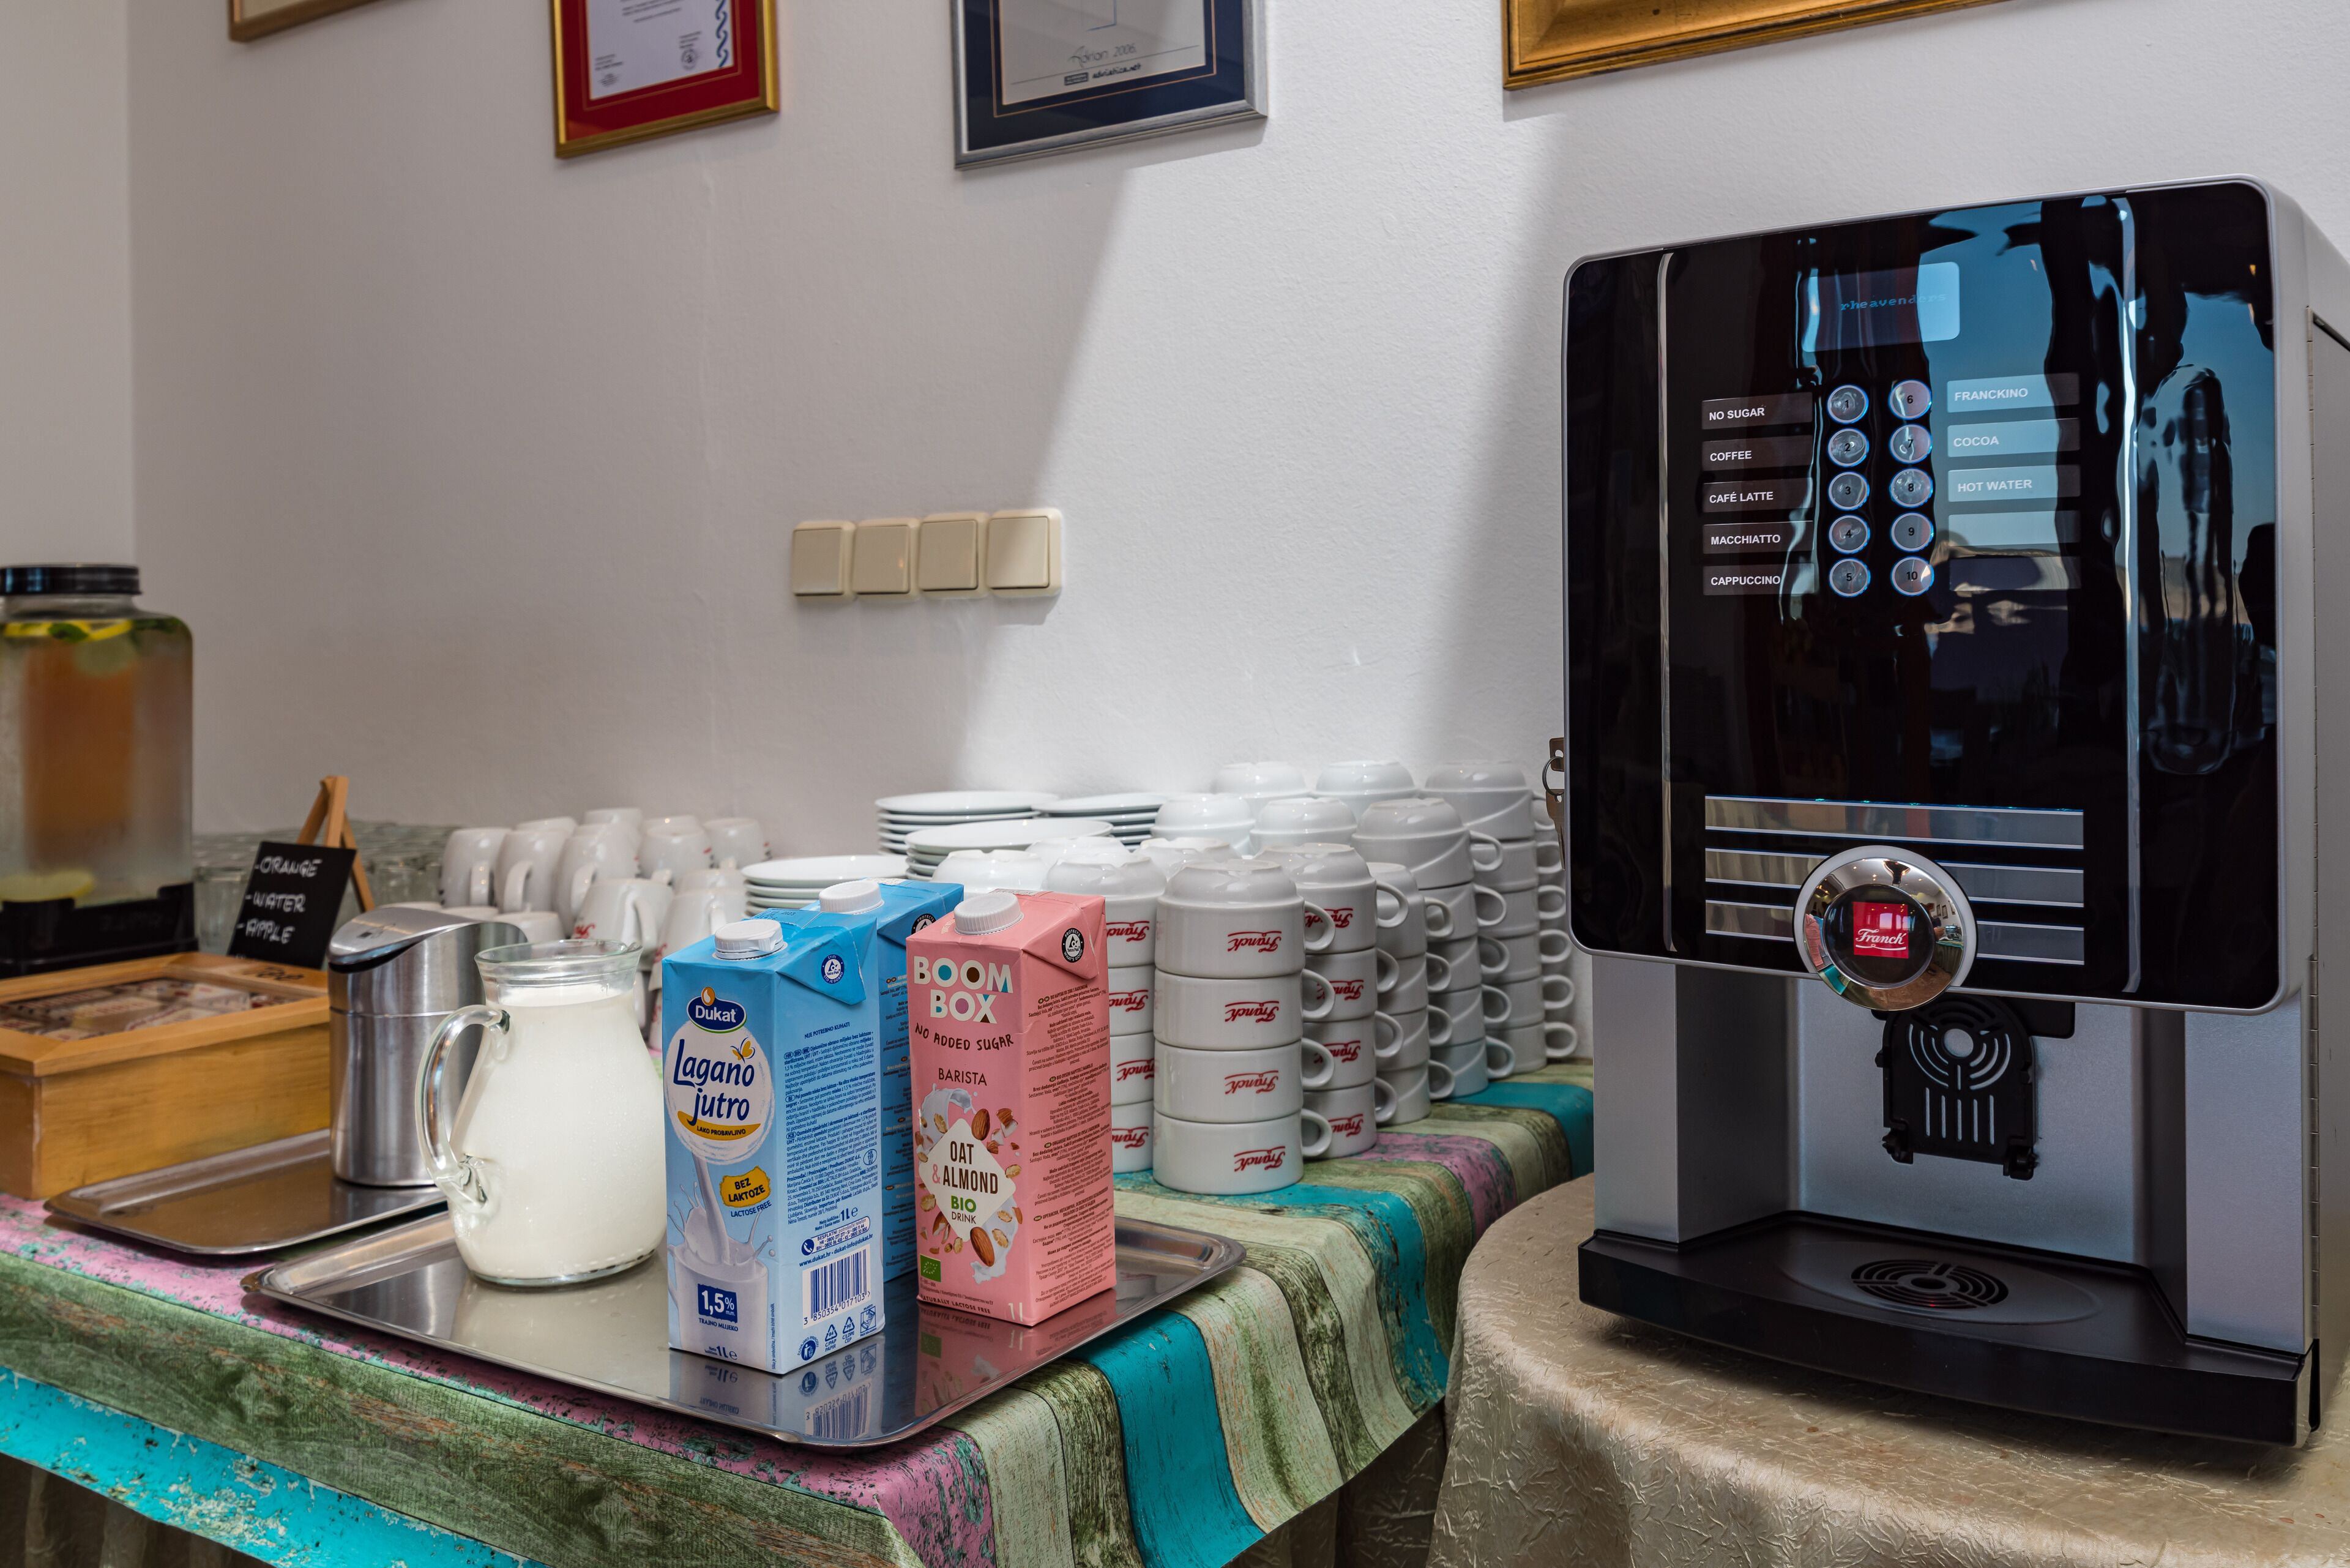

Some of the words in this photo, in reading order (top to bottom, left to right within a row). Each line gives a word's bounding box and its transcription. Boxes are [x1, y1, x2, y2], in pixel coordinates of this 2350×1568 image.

[1840, 294, 1946, 311] rheavenders
[1907, 395, 1914, 405] 6
[1954, 388, 2028, 401] FRANCKINO
[1845, 400, 1850, 408] 1
[1709, 411, 1725, 421] NO
[1727, 407, 1765, 419] SUGAR
[1845, 442, 1851, 452] 2
[1908, 438, 1914, 449] 7
[1953, 436, 1999, 447] COCOA
[1710, 450, 1752, 461] COFFEE
[1845, 486, 1851, 496] 3
[1908, 483, 1914, 493] 8
[1958, 482, 1983, 492] HOT
[1986, 479, 2032, 491] WATER
[1709, 491, 1737, 503] CAFÉ
[1740, 491, 1774, 502] LATTE
[1846, 529, 1853, 539] 4
[1908, 527, 1915, 537] 9
[1710, 534, 1781, 545] MACCHIATTO
[1710, 576, 1781, 586] CAPPUCCINO
[1846, 572, 1852, 582] 5
[1906, 571, 1918, 581] 10
[1064, 929, 1081, 938] PROTECTS
[1856, 928, 1907, 945] Franck
[1227, 935, 1282, 953] Franck
[914, 956, 1013, 994] BOOM
[930, 989, 998, 1024] BOX
[695, 1005, 736, 1023] Dukat
[1225, 1006, 1280, 1023] Franck
[813, 1027, 834, 1036] POTREBNO
[915, 1023, 929, 1039] NO
[934, 1034, 971, 1051] ADDED
[977, 1034, 1014, 1051] SUGAR
[673, 1039, 755, 1088] Lagano
[938, 1067, 987, 1086] BARISTA
[1225, 1075, 1278, 1094] Franck
[687, 1088, 750, 1126] jutro
[696, 1126, 710, 1134] LAKO
[950, 1140, 974, 1165] OAT
[1234, 1151, 1286, 1173] Franck
[734, 1178, 752, 1190] BEZ
[932, 1163, 941, 1184] &
[942, 1165, 998, 1194] ALMOND
[728, 1184, 766, 1203] LAKTOZE
[731, 1207, 757, 1217] LACTOSE
[756, 1200, 772, 1212] FREE
[951, 1195, 977, 1213] BIO
[952, 1211, 976, 1225] DRINK
[818, 1231, 837, 1240] BESPLATNI
[799, 1251, 830, 1267] www.dukat.hr
[834, 1234, 873, 1253] dukat-info@dukat.hr
[702, 1290, 735, 1315] 1,5%
[813, 1306, 838, 1321] 850354
[841, 1293, 865, 1310] 017103
[952, 1301, 976, 1310] LACTOSE
[699, 1317, 717, 1327] TRAJNO
[718, 1323, 739, 1332] MLIJEKO
